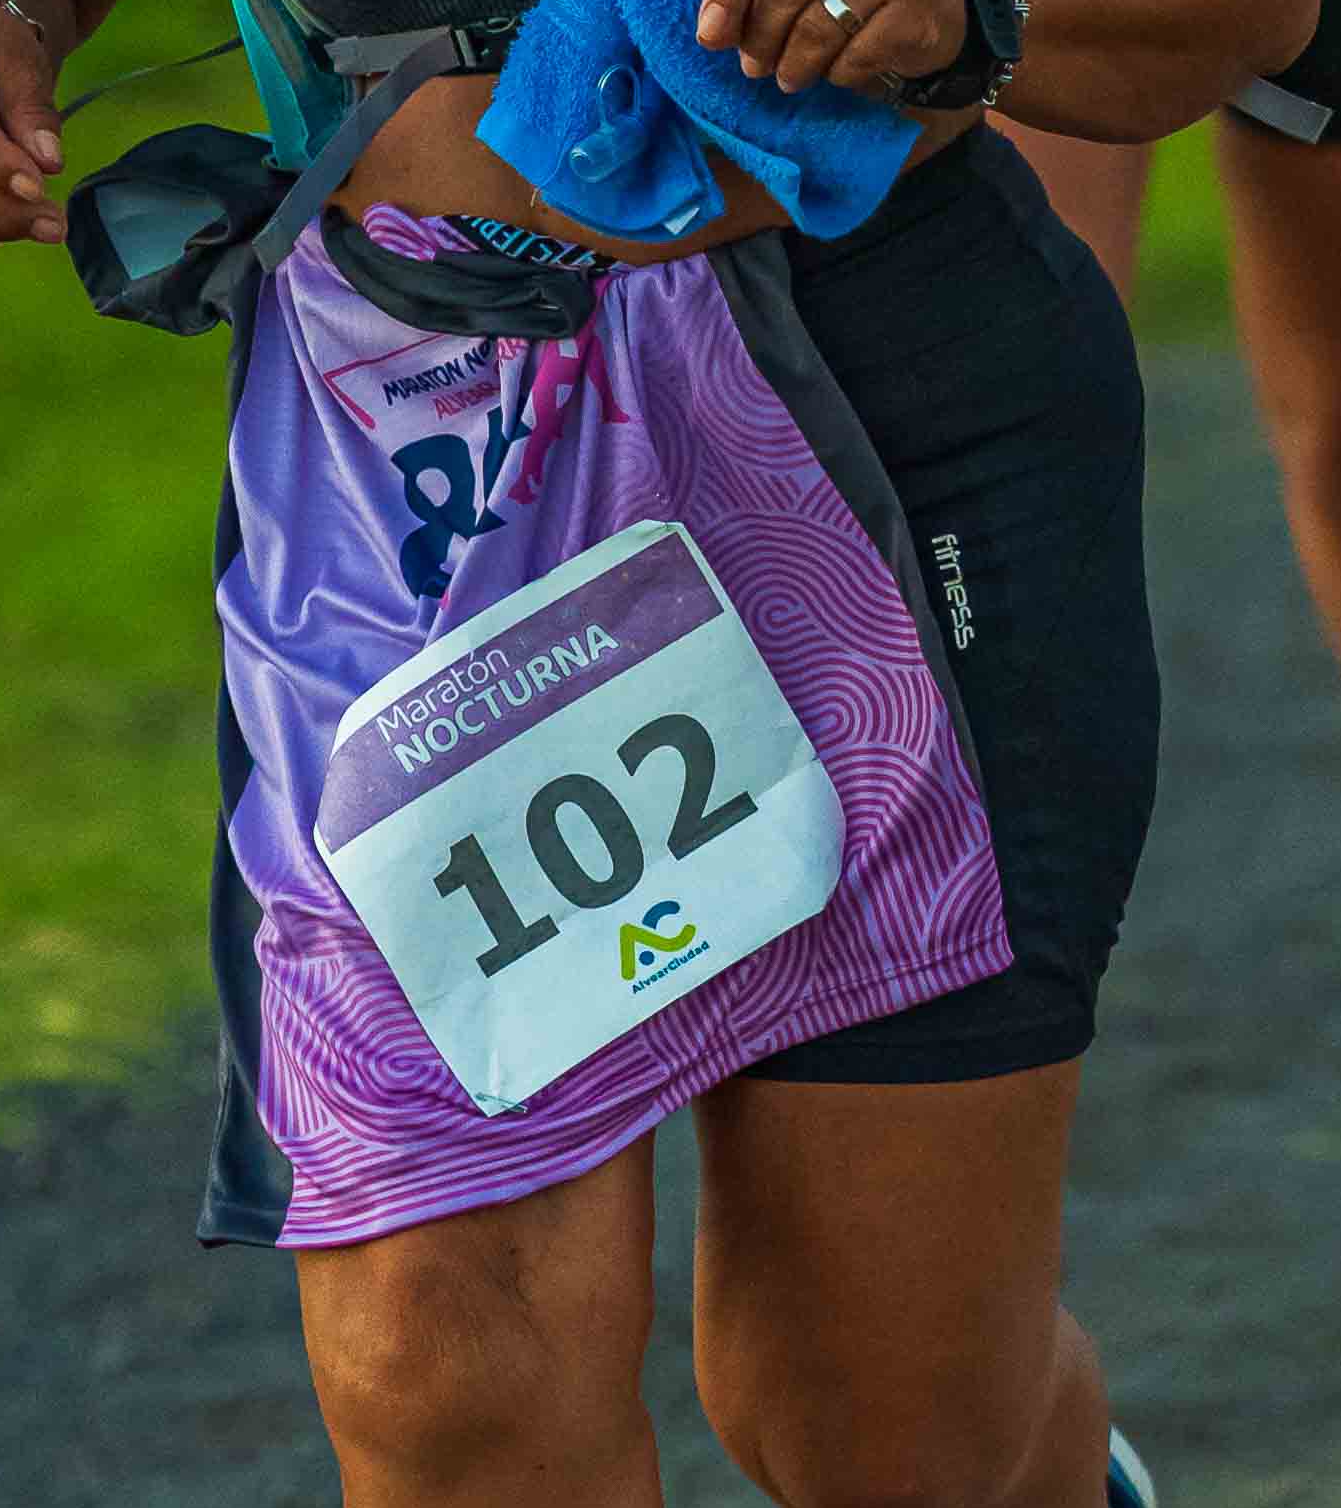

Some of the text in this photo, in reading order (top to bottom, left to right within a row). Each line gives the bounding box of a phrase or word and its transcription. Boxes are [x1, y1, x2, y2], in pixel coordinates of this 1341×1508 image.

[375, 647, 510, 744] Maratón
[392, 624, 620, 774] NOCTURNA
[433, 713, 759, 979] 102
